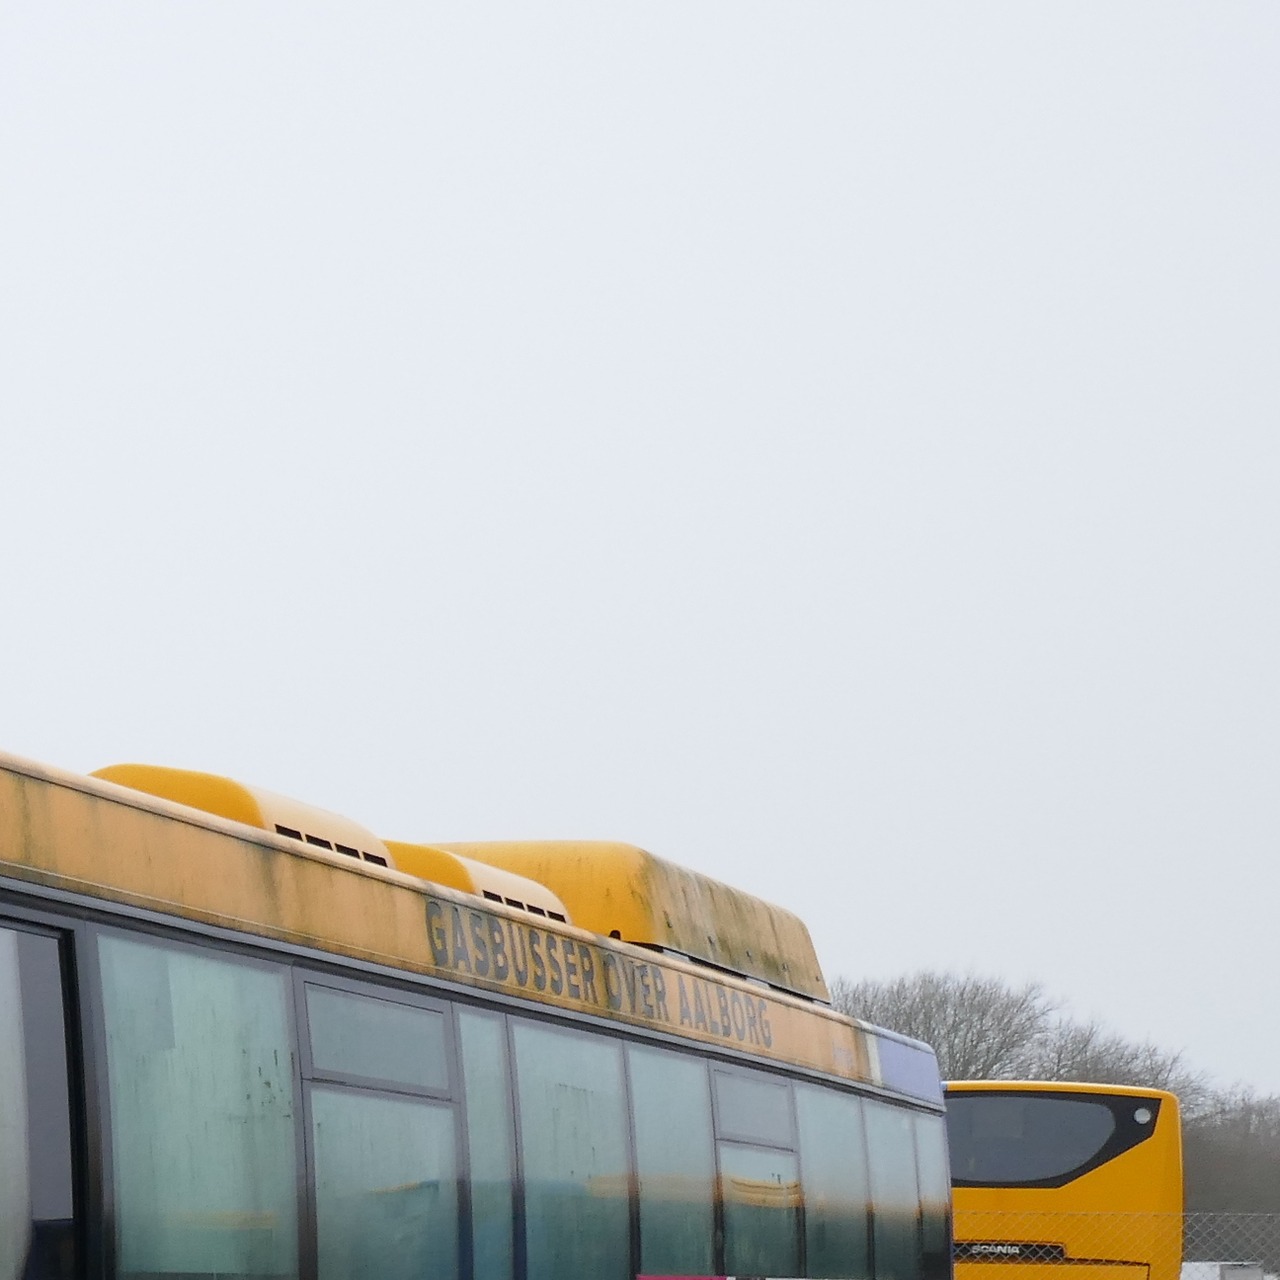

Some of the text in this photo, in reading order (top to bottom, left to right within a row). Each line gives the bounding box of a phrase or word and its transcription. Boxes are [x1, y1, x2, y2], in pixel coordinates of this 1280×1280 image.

[425, 900, 773, 1049] GASBUSSER OVER AALBORG
[971, 1244, 1020, 1255] SCANIA
